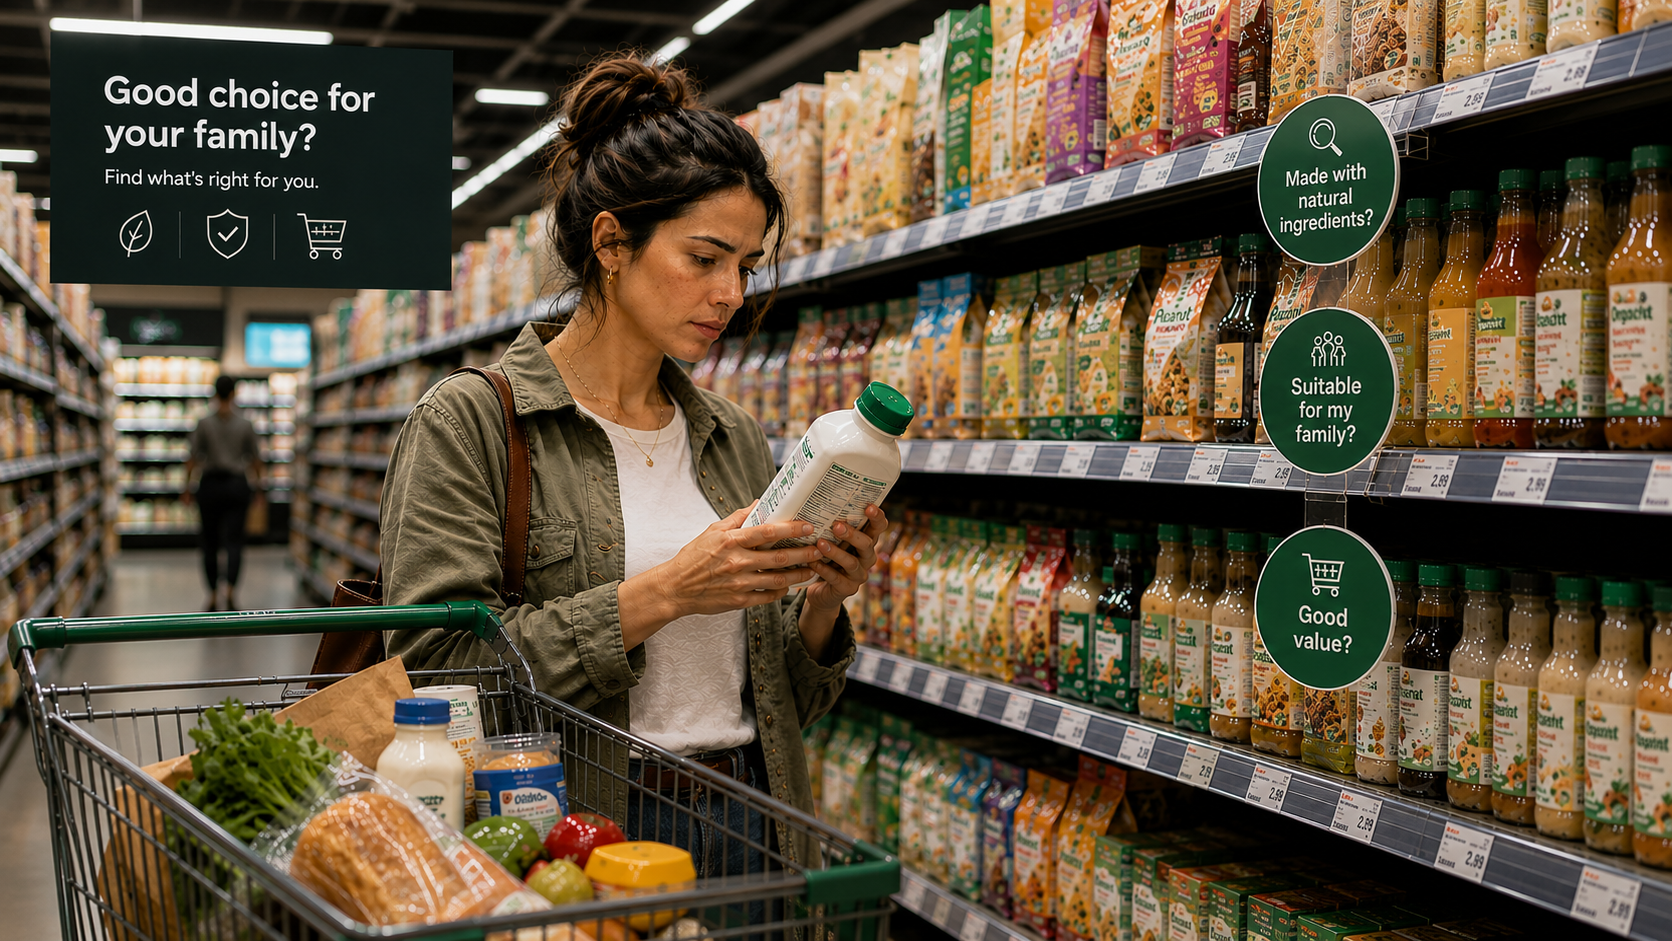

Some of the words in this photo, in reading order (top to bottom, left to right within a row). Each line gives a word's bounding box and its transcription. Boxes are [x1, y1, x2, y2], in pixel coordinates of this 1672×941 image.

[104, 75, 198, 106] Good
[209, 78, 318, 111] choice
[328, 82, 375, 113] for
[105, 125, 185, 154] your
[194, 119, 316, 158] family?
[105, 168, 143, 185] Find
[148, 170, 204, 187] what's
[209, 171, 249, 191] right
[254, 172, 278, 188] for
[283, 176, 319, 192] you.
[1286, 167, 1329, 188] Made
[1332, 162, 1367, 182] with
[1297, 187, 1353, 209] natural
[1279, 208, 1374, 236] ingredients?
[1291, 375, 1362, 396] Suitable
[1299, 400, 1323, 419] for
[1327, 405, 1353, 423] my
[1295, 425, 1356, 448] family?
[1298, 605, 1348, 628] Good
[1293, 631, 1353, 654] value?
